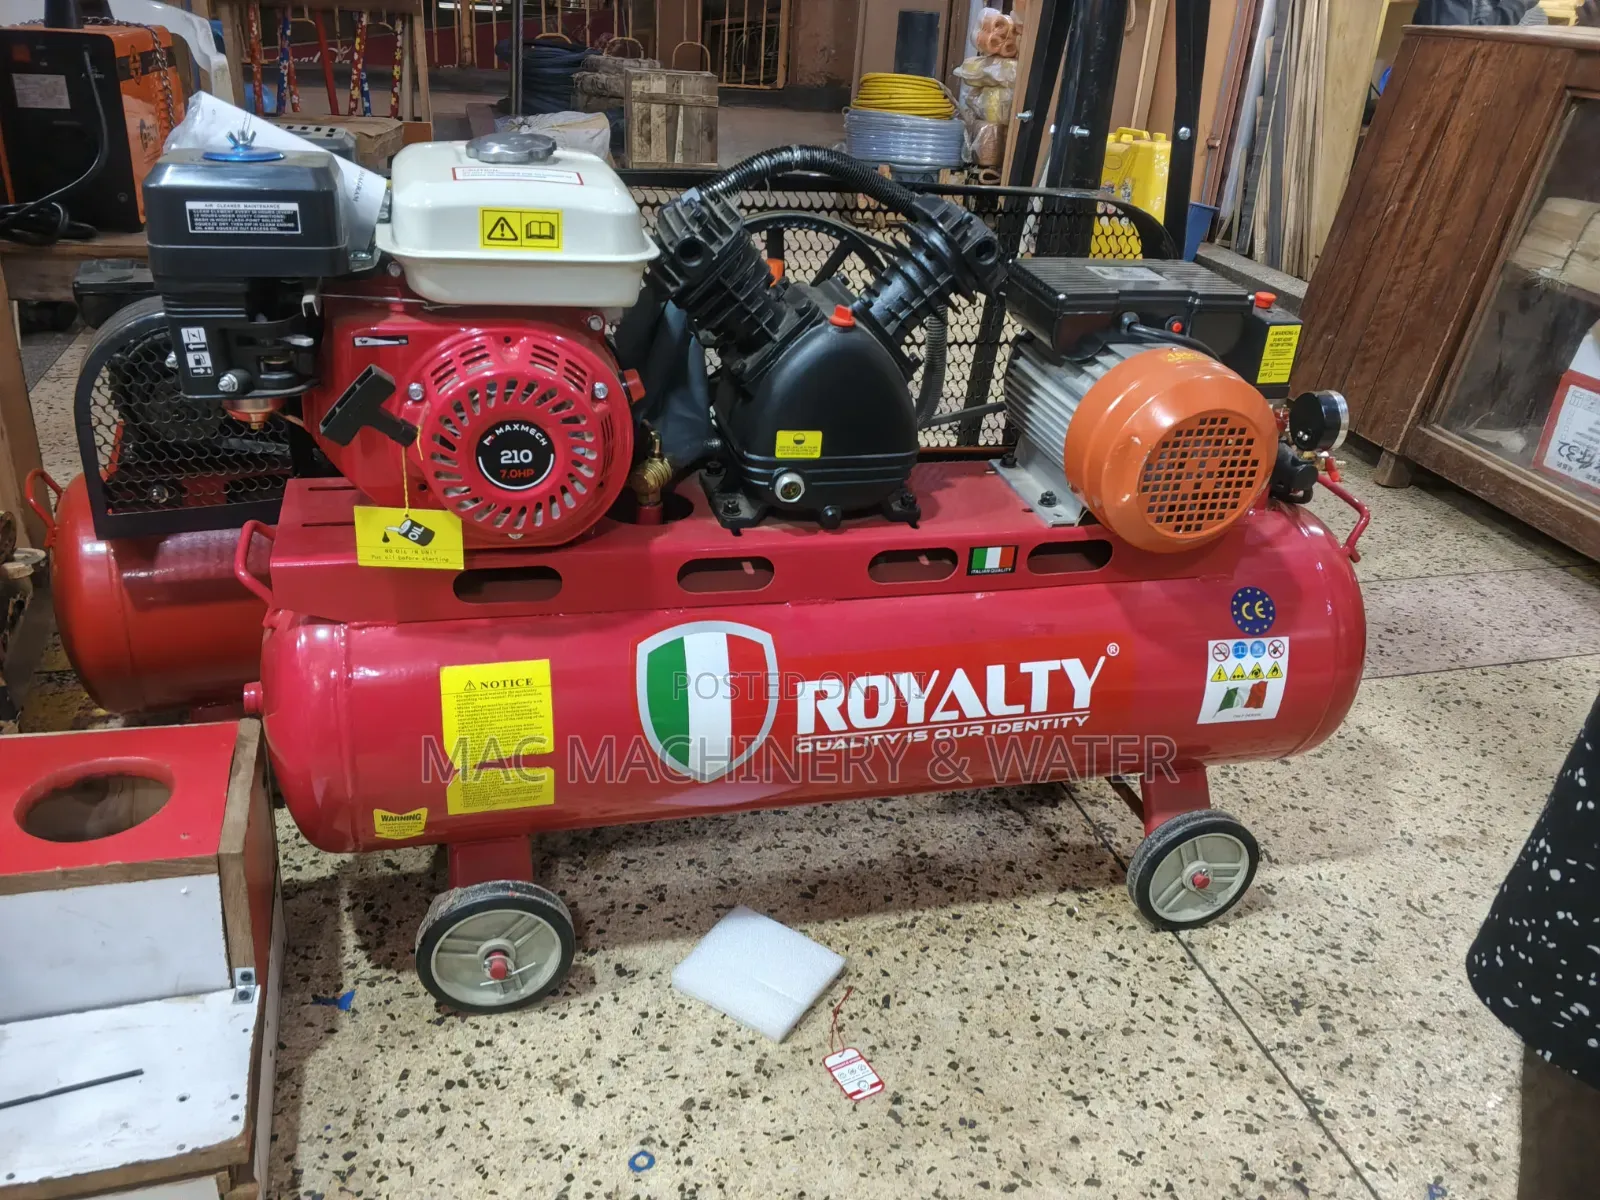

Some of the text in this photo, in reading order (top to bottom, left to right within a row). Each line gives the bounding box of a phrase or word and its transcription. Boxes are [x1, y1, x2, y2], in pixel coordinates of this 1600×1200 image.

[494, 424, 548, 446] MAXMECH
[500, 449, 533, 464] 210
[500, 468, 535, 479] 7.0HP
[408, 526, 424, 541] OIL
[1242, 600, 1266, 620] CE
[480, 678, 534, 690] NOTICE
[795, 656, 1106, 735] ROYALTY
[796, 715, 1091, 754] QUALITY IS OUR IDENTITY
[380, 814, 422, 822] WARNING
